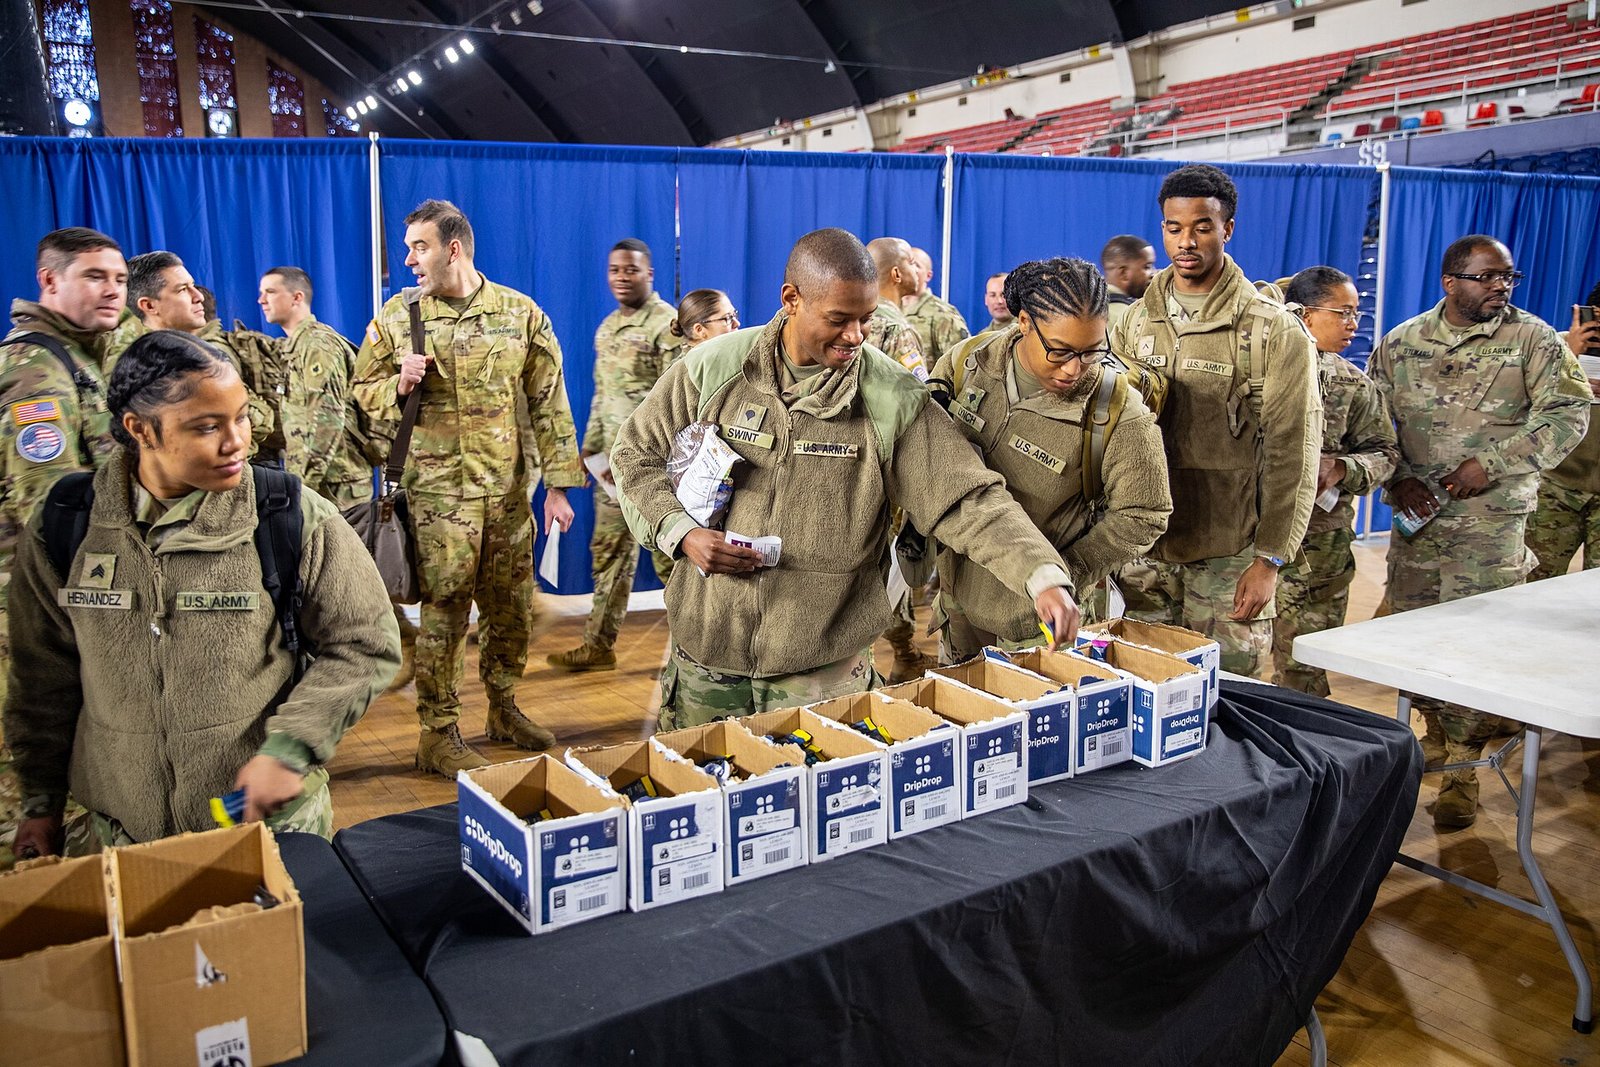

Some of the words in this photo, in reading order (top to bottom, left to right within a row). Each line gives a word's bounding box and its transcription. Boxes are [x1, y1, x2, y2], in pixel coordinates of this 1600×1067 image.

[1492, 347, 1513, 355] ARMY
[1186, 360, 1200, 369] U.S.
[1202, 361, 1227, 373] ARMY
[957, 406, 977, 425] LYNCH
[727, 428, 760, 443] SWINT
[802, 442, 820, 454] U.S.
[821, 443, 849, 455] ARMY
[1014, 438, 1031, 455] U.S.
[1031, 448, 1060, 469] ARMY
[67, 591, 122, 606] HERNANDEZ
[183, 596, 207, 608] U.S.
[211, 596, 251, 608] ARMY
[1087, 717, 1119, 732] DripDrop
[1170, 713, 1199, 728] DripDrop
[1027, 735, 1060, 748] DripDrop
[903, 775, 943, 793] DripDrop
[476, 822, 523, 879] DripDrop
[203, 1041, 245, 1060] WARRIOR
